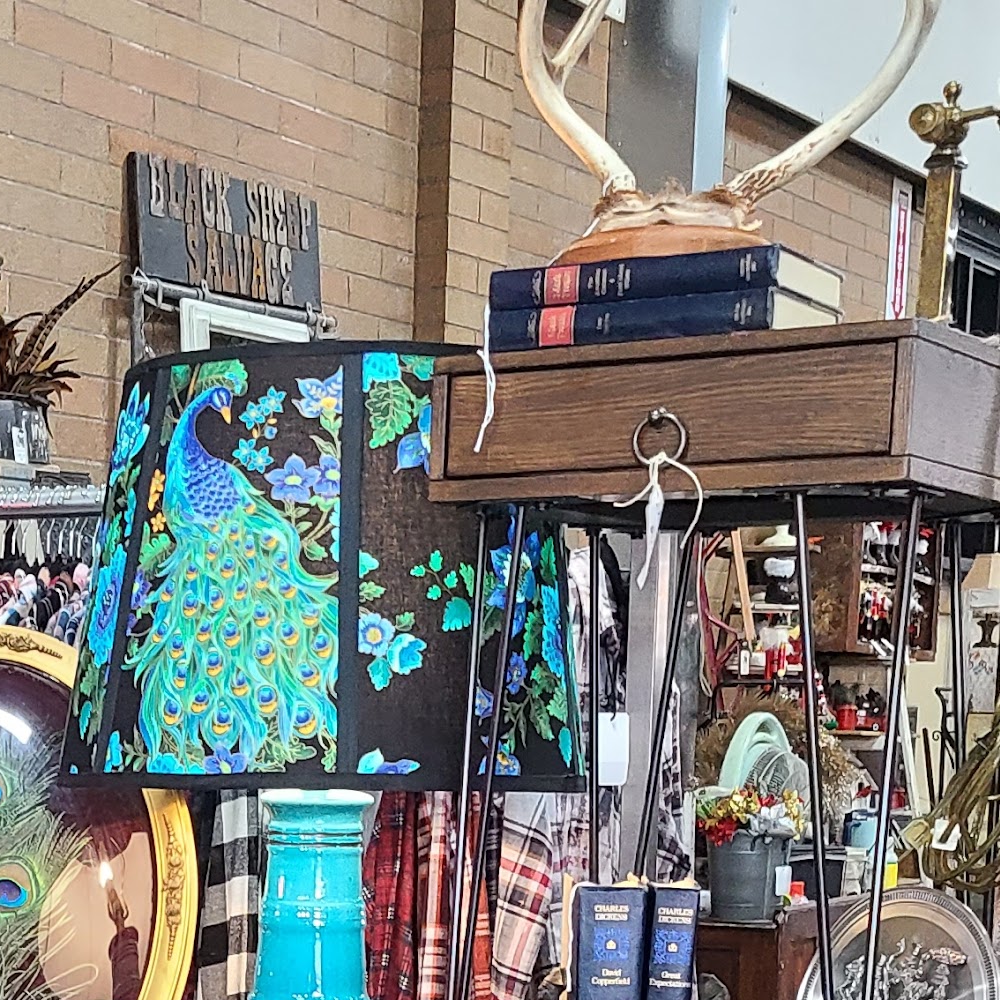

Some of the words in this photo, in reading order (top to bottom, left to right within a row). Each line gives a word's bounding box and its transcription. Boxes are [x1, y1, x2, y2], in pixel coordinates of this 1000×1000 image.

[149, 153, 234, 234] BLACK
[246, 178, 313, 251] SHEEP
[185, 224, 295, 306] SALVAGE
[593, 904, 630, 914] CHARLES
[657, 906, 694, 917] CHARLES
[594, 913, 629, 921] DICKENS
[657, 915, 692, 925] DICKENS
[601, 968, 622, 977] David
[661, 971, 682, 980] Great
[591, 976, 631, 987] Copperfield
[649, 977, 692, 989] Expectations
